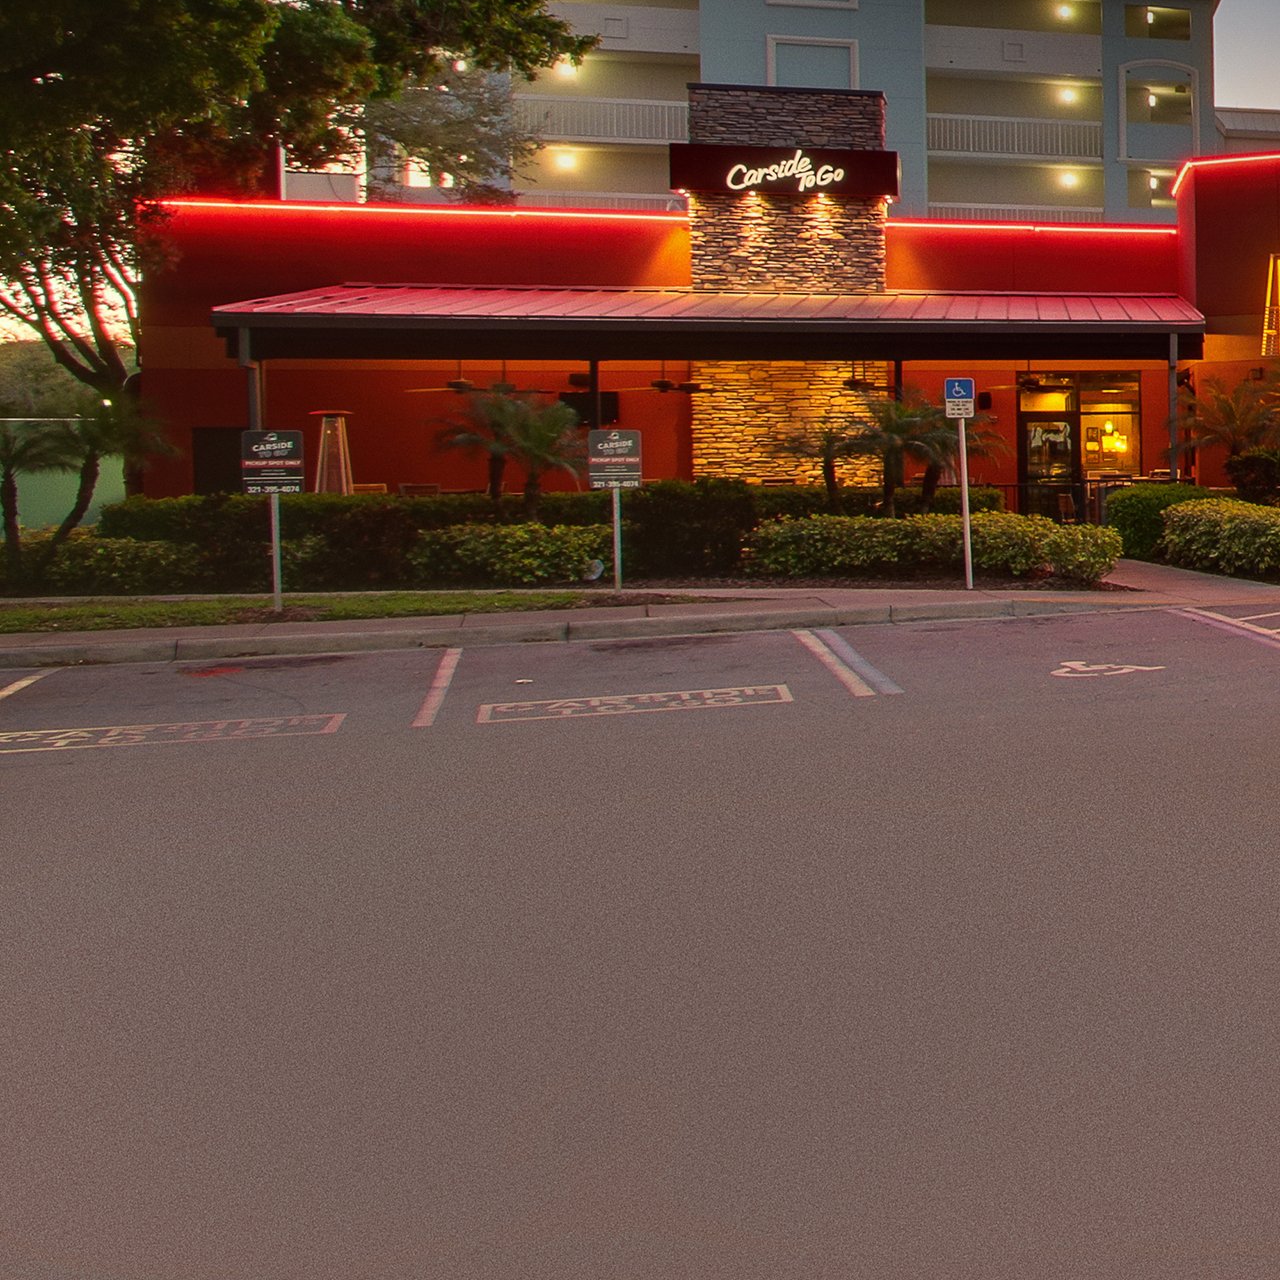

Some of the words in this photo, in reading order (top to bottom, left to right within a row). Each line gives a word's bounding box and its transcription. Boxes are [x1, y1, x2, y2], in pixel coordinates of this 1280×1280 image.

[726, 149, 812, 190] Carside
[252, 441, 294, 452] CARSIDE
[597, 440, 633, 450] CARSIDE
